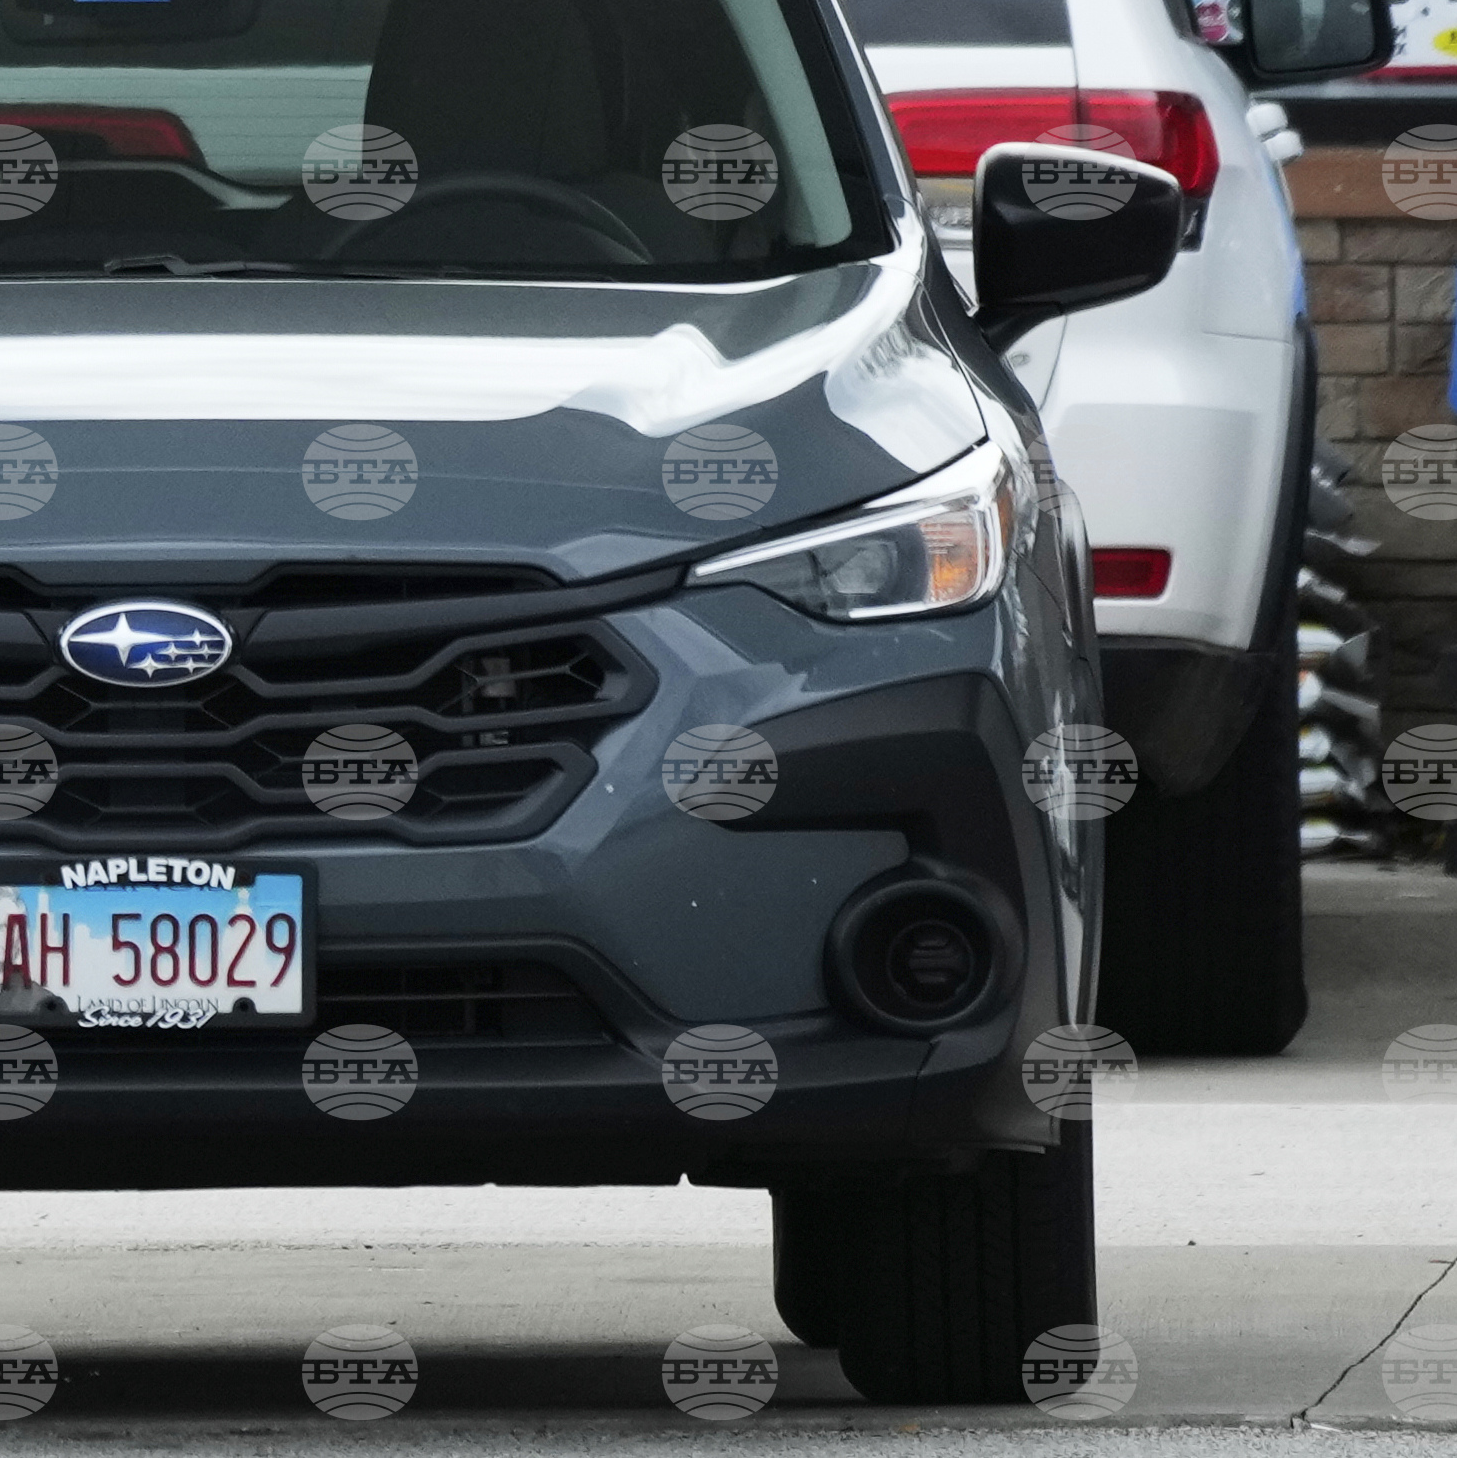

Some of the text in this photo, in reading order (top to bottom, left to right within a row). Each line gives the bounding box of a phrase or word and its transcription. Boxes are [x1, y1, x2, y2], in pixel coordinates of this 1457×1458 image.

[60, 856, 236, 890] NAPLETON
[2, 912, 298, 988] AH 58029
[77, 1005, 218, 1030] Since 1931
